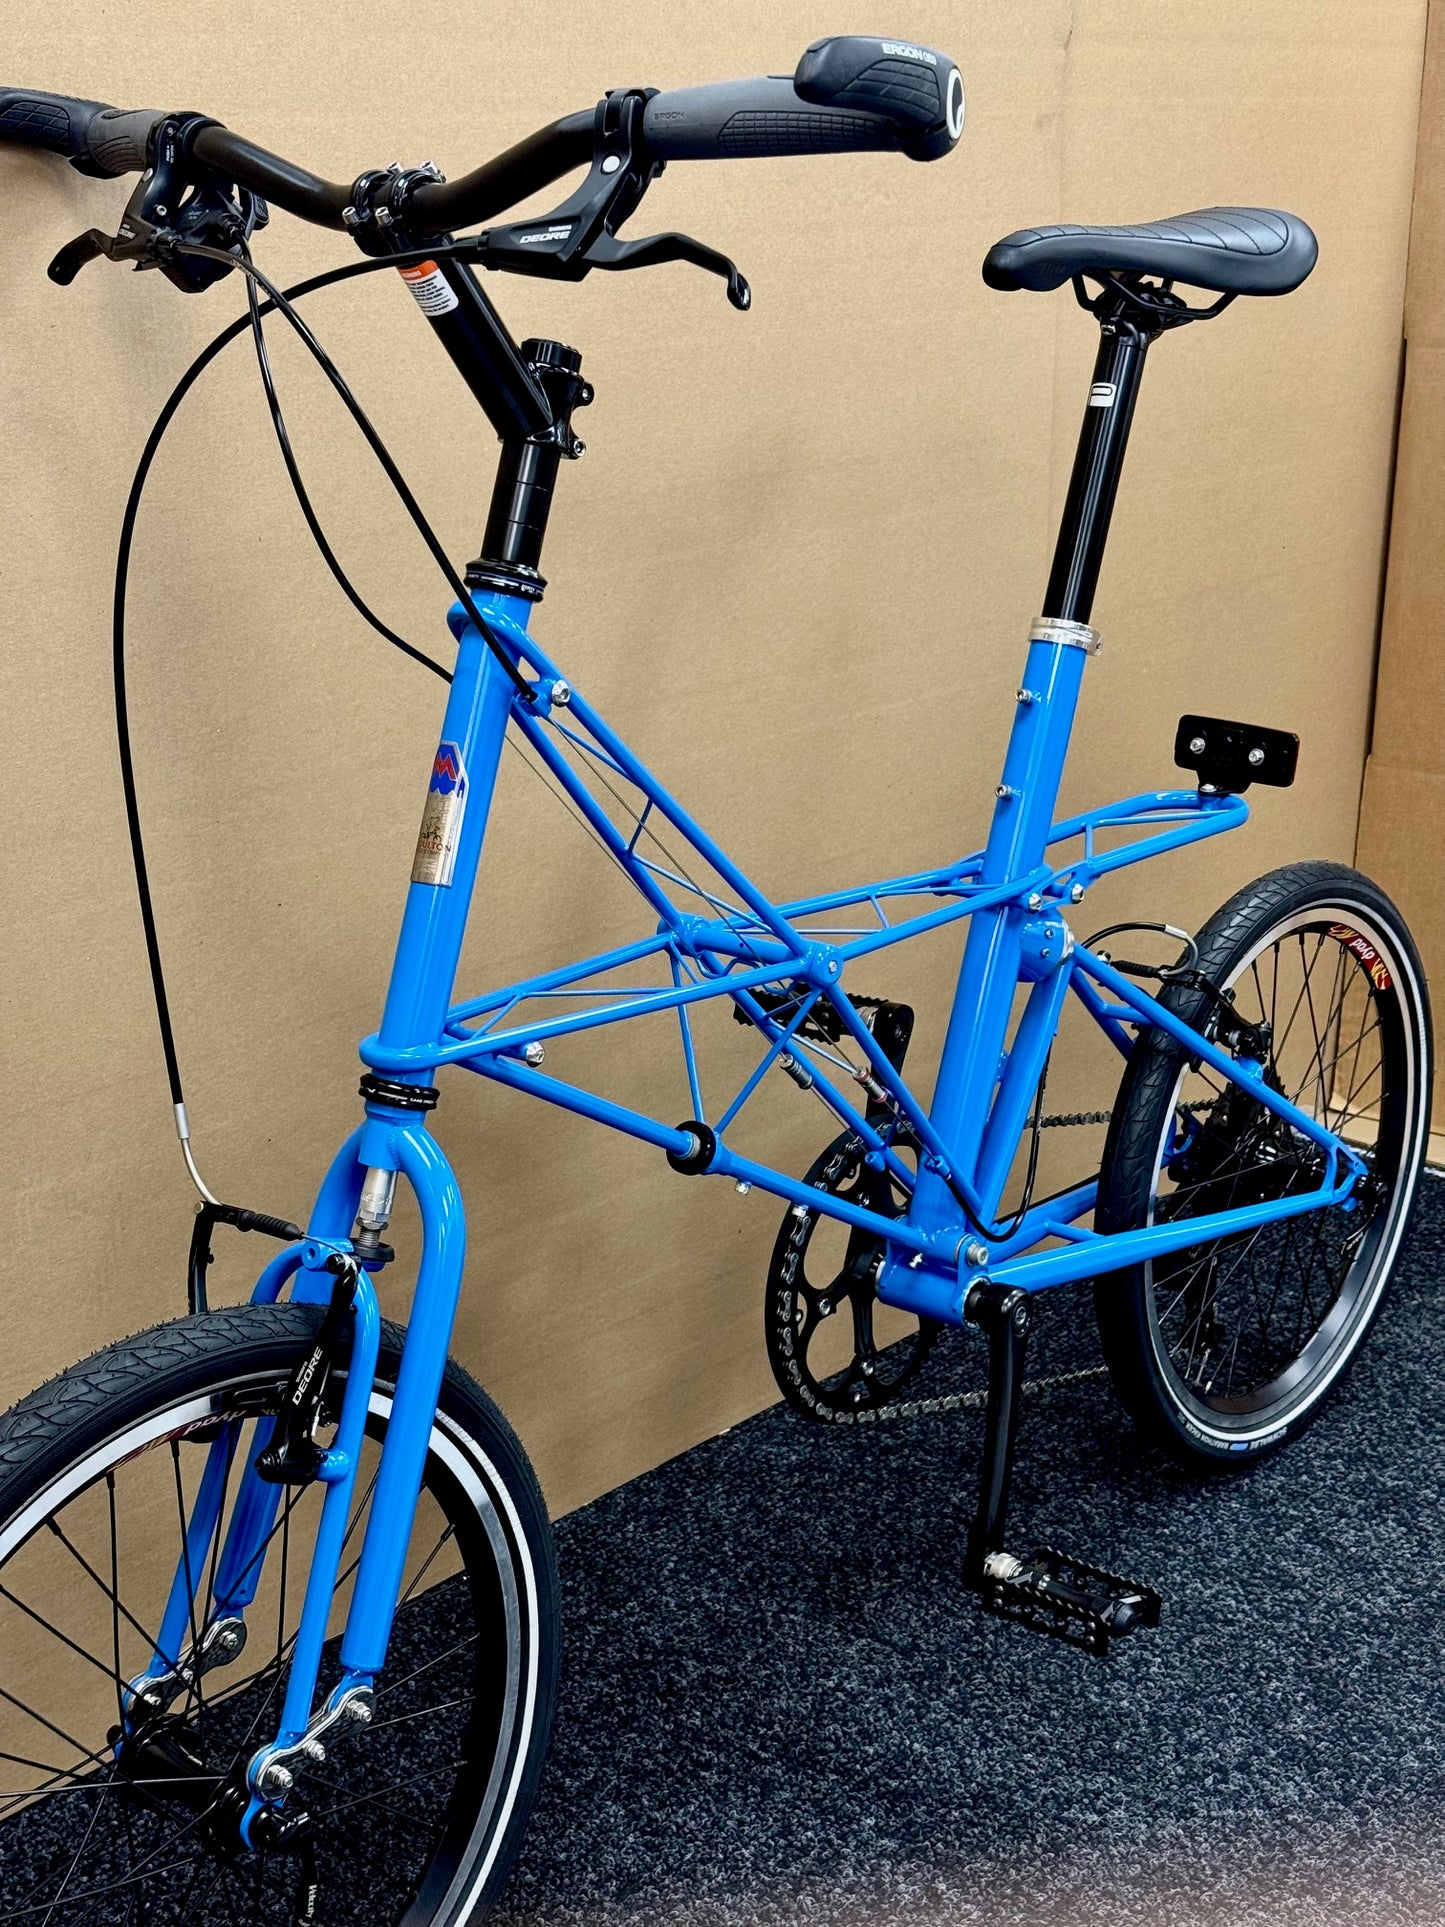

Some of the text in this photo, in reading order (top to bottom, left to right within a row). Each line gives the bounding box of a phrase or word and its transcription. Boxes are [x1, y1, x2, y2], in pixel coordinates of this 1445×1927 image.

[881, 42, 923, 61] ERGON
[520, 231, 571, 244] DEORE
[291, 1345, 324, 1406] DEORE
